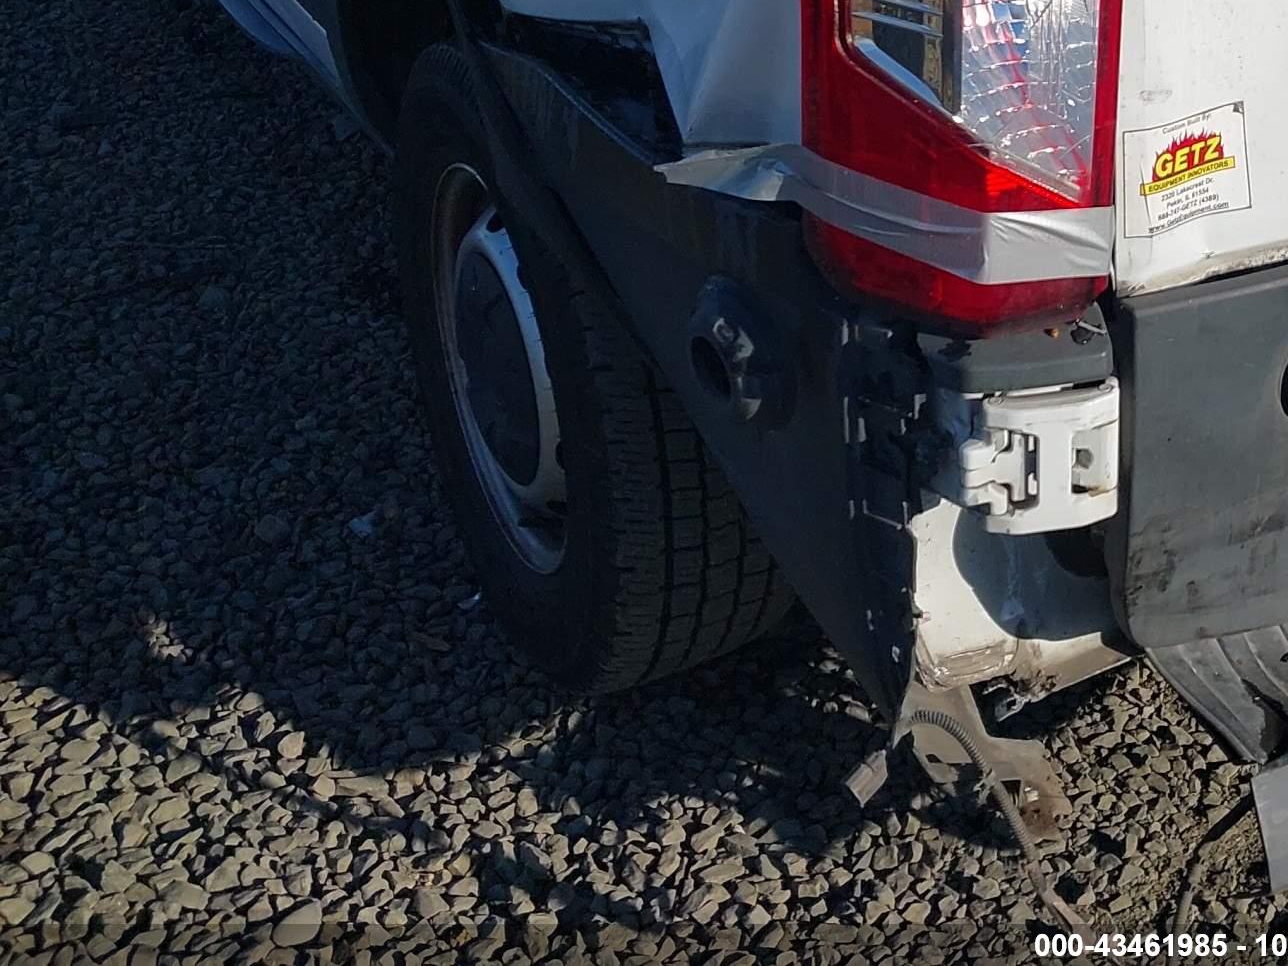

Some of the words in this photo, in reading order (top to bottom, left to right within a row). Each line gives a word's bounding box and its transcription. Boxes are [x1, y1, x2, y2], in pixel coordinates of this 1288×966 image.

[1148, 175, 1186, 193] EQUIPMENT
[1187, 159, 1229, 180] INNOVATORS
[1154, 135, 1222, 179] GETZ
